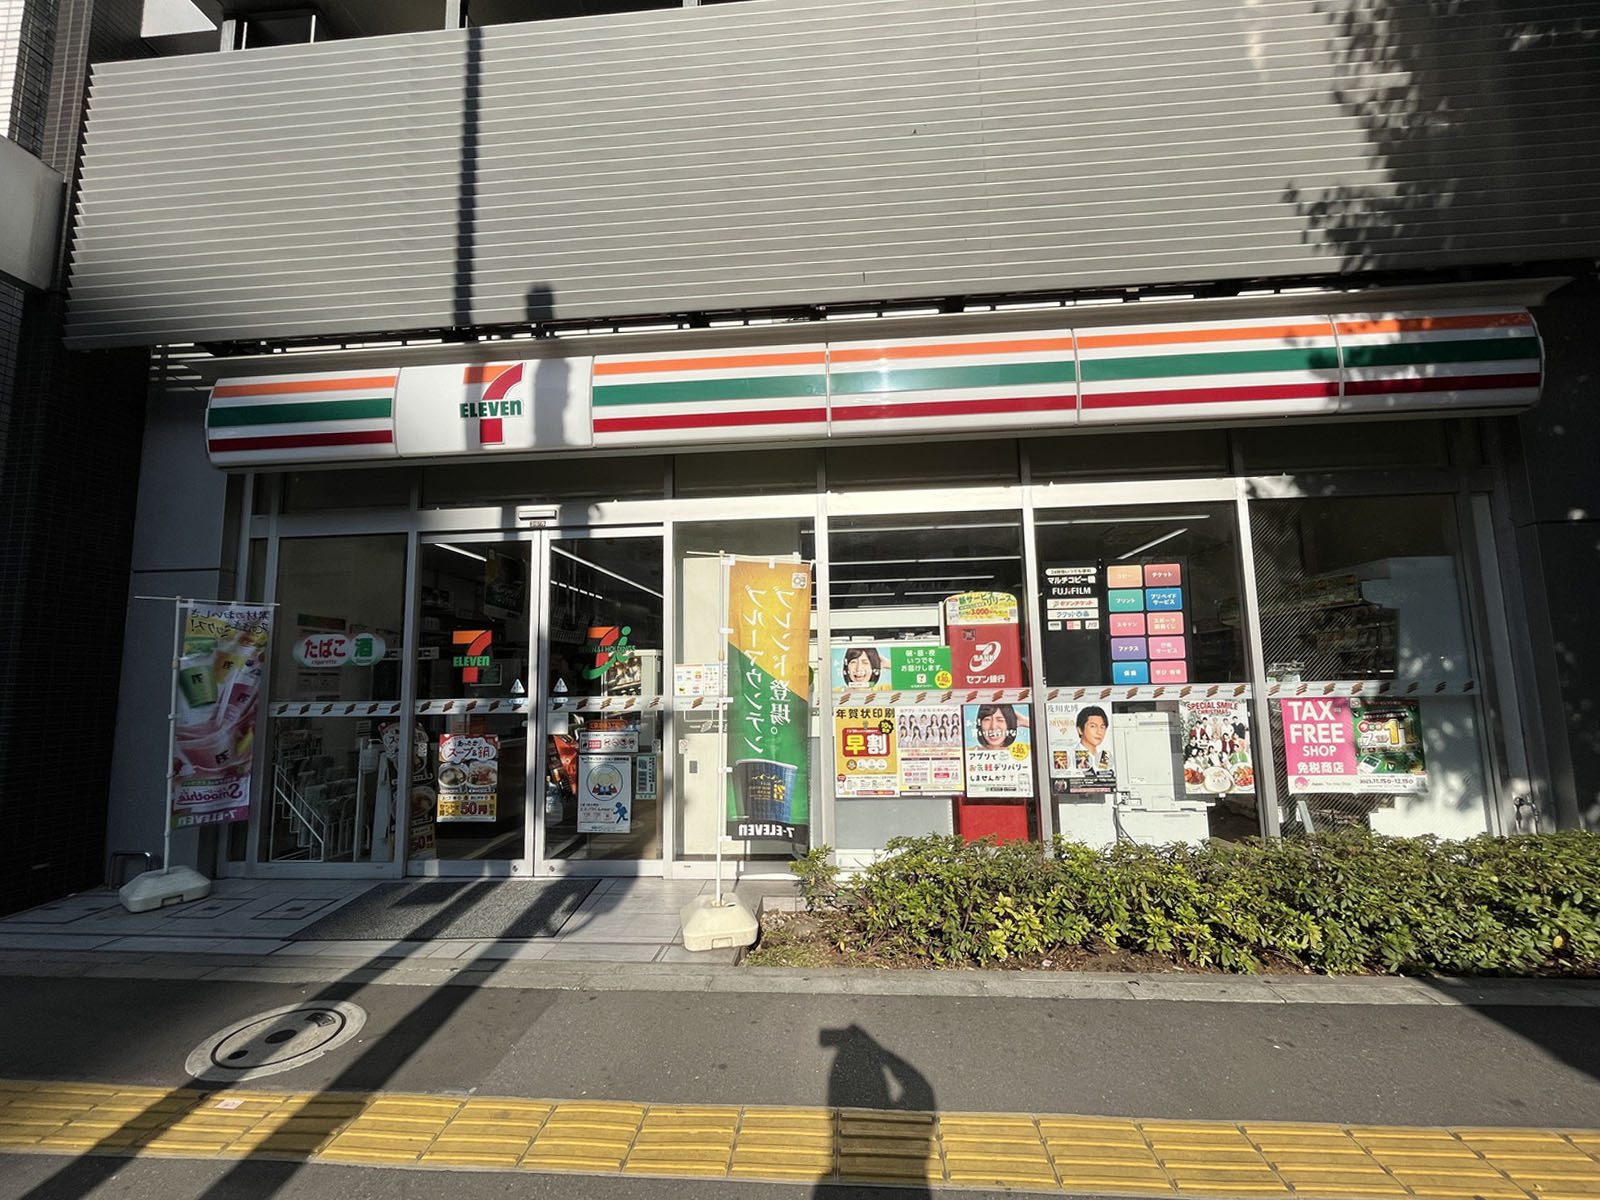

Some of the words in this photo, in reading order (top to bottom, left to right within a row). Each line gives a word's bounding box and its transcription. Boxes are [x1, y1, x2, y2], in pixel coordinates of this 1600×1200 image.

[1052, 587, 1091, 595] FUJIFILM
[304, 639, 346, 658] たばこ
[355, 638, 373, 657] 酒
[966, 675, 1005, 684] セブン銀行
[1187, 702, 1215, 711] SPECIAL
[1217, 701, 1238, 710] SMILE
[836, 708, 895, 719] 年賀状印刷
[1289, 722, 1346, 744] FREE
[845, 733, 888, 755] 早割
[969, 752, 998, 760] アプリで
[1302, 745, 1337, 757] SHOP
[969, 763, 1028, 772] お気軽デリバリー
[1297, 762, 1344, 774] 免税商店
[460, 801, 488, 815] 50円
